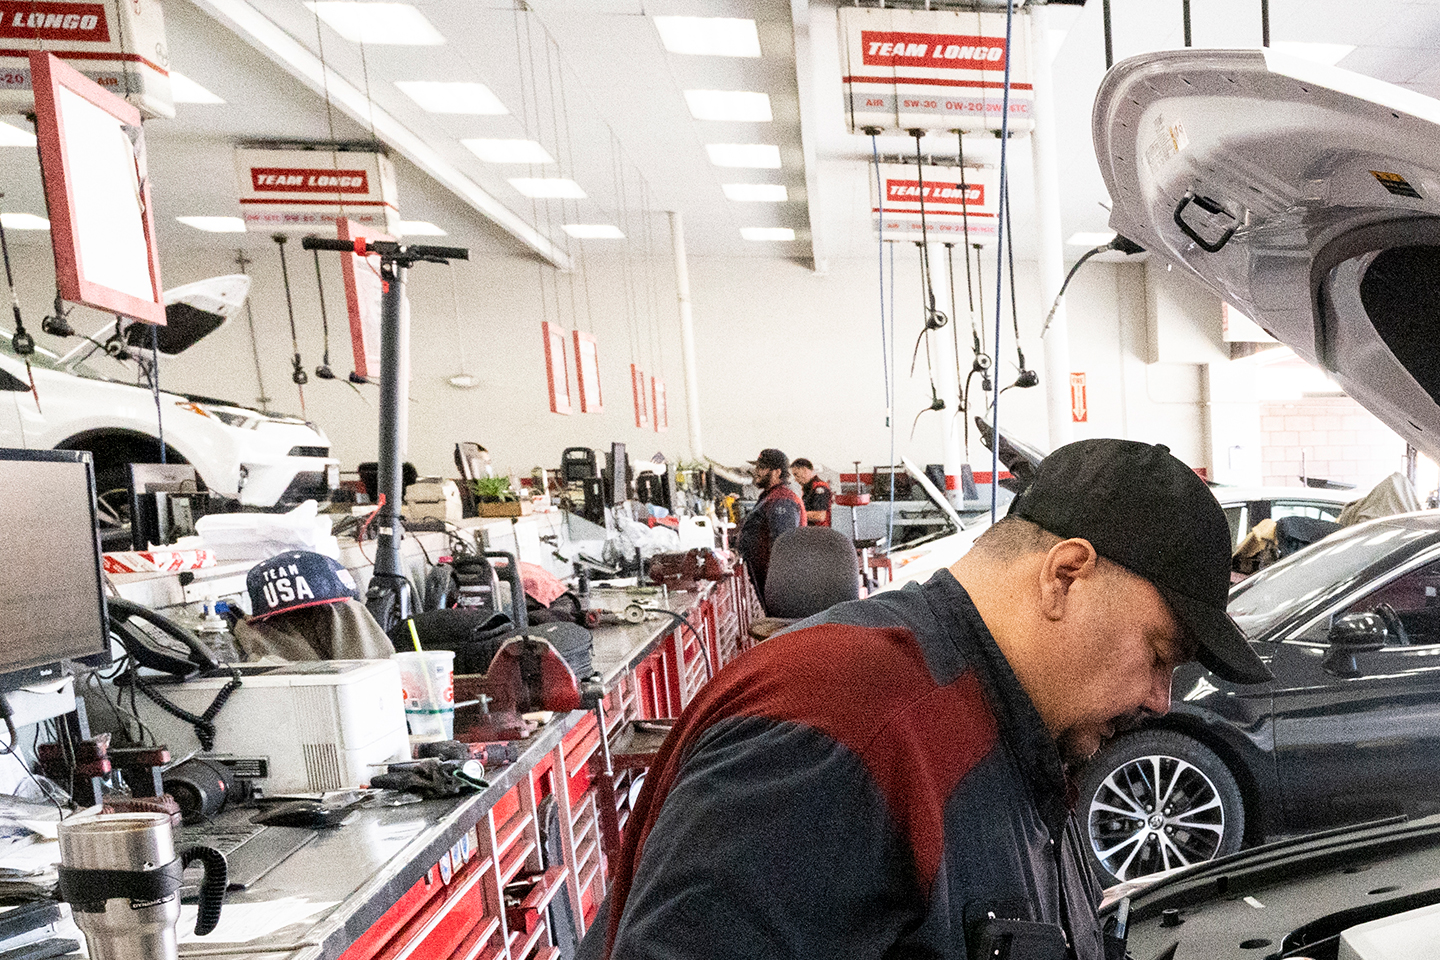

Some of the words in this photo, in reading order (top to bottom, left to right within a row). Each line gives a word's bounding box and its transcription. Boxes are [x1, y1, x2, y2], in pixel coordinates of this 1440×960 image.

[12, 12, 98, 30] LONGO
[868, 42, 928, 57] TEAM
[932, 45, 1003, 61] LONGO
[866, 98, 884, 107] AIR
[257, 174, 303, 186] TEAM
[308, 176, 363, 188] LONGO
[890, 185, 930, 197] TEAM
[263, 564, 299, 582] TEAM
[263, 576, 315, 608] USA
